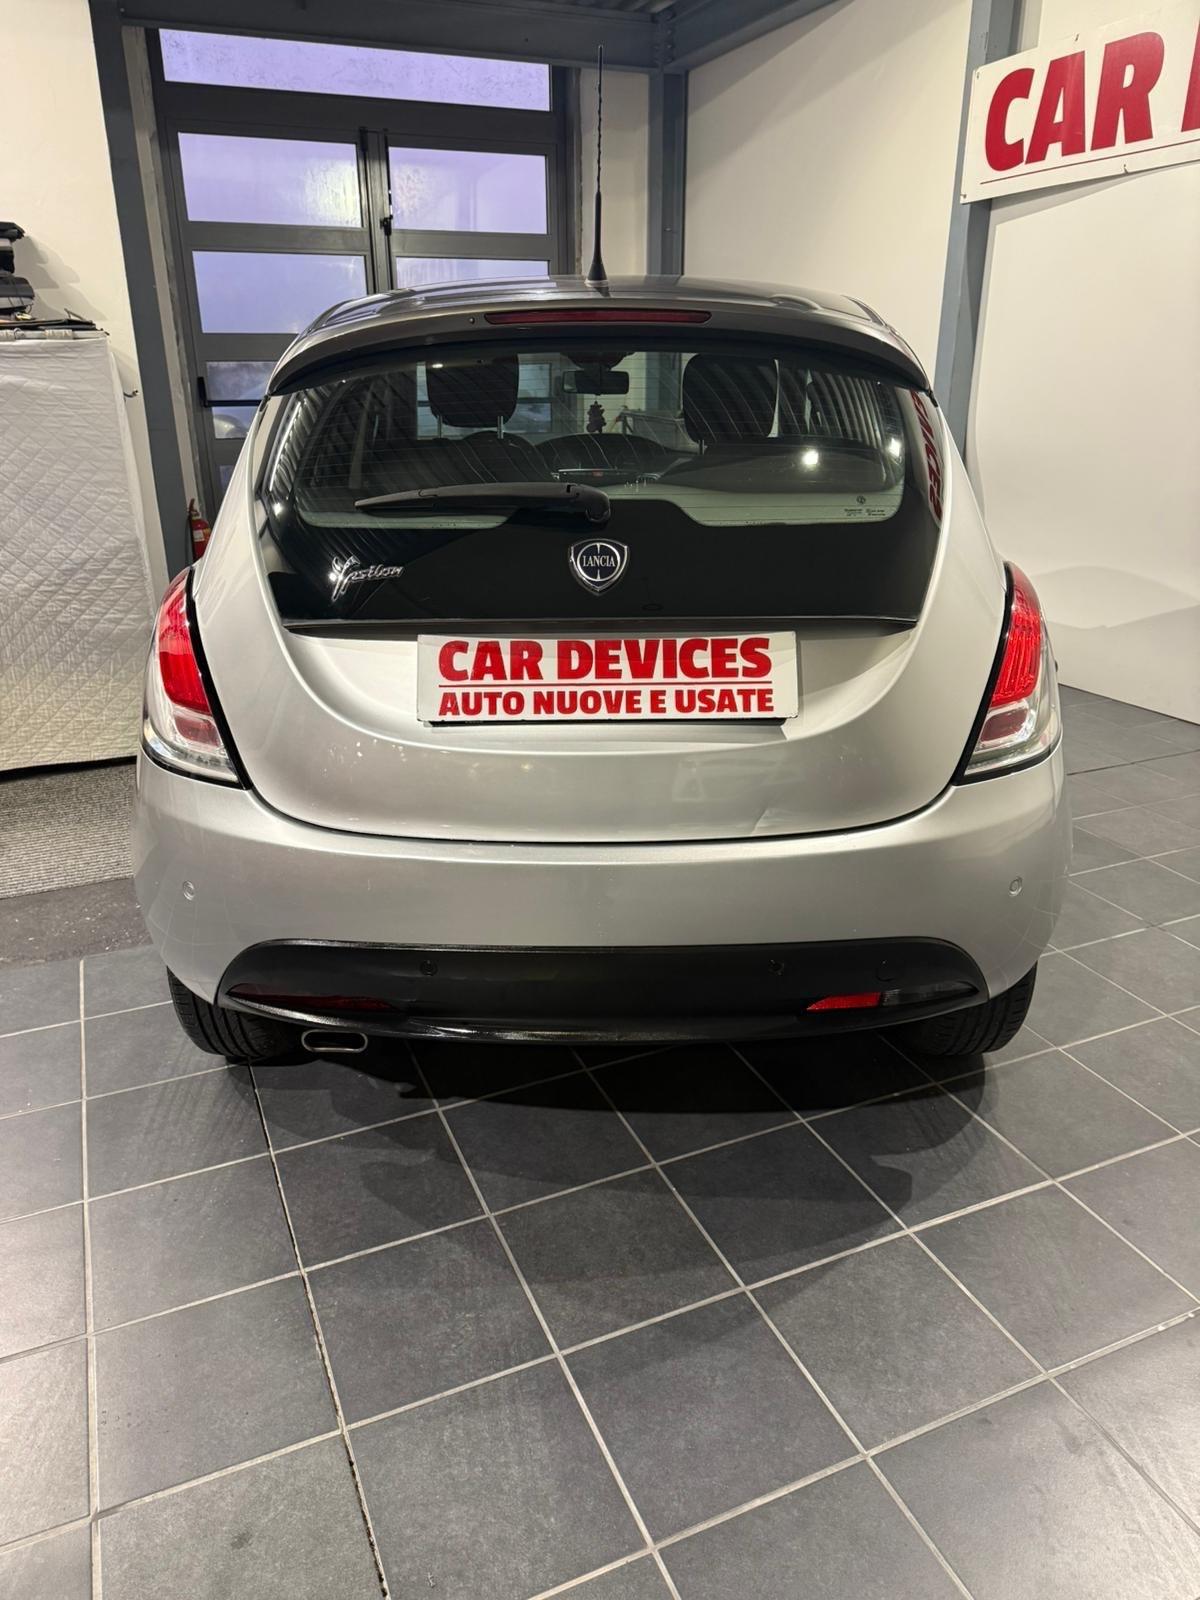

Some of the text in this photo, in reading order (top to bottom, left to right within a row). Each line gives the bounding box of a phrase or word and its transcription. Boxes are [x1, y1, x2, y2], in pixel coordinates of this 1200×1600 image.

[984, 31, 1165, 172] CAR
[330, 556, 405, 601] Ypsilon
[583, 555, 616, 567] LANCIA
[438, 637, 772, 682] CAR DEVICES
[439, 688, 773, 716] AUTO NUOVE E USATE
